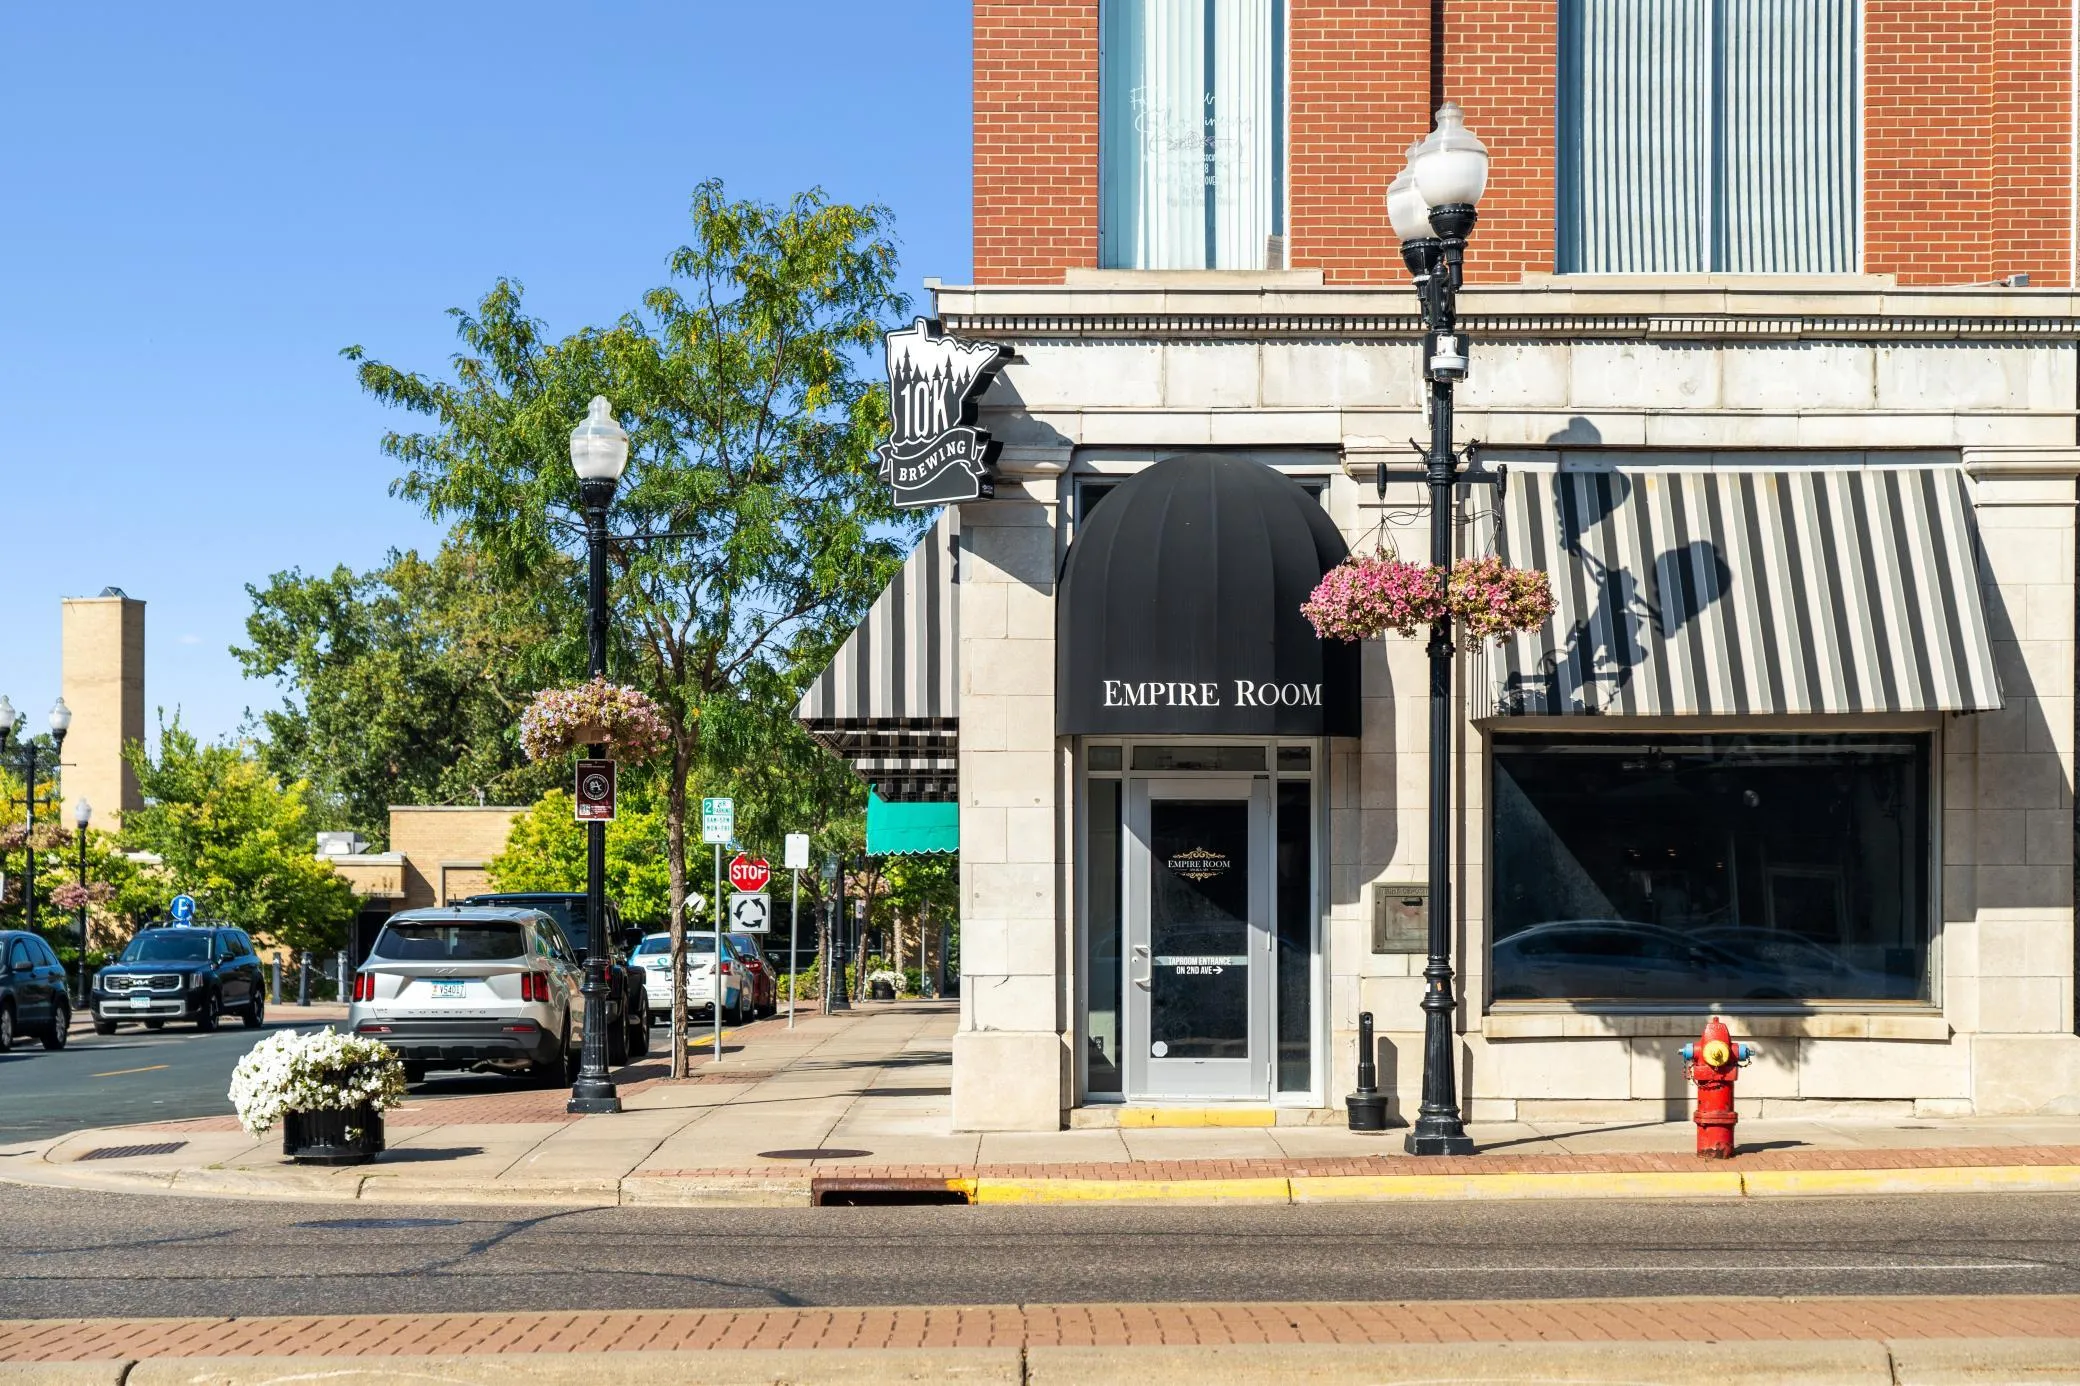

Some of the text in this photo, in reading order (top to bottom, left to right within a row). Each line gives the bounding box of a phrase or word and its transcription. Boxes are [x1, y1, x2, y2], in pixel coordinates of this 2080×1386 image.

[901, 377, 949, 439] 10K
[898, 440, 967, 483] BREWING
[1103, 679, 1323, 707] EMPIRE ROOM
[705, 802, 712, 813] 2
[732, 864, 767, 880] STOP
[1168, 860, 1231, 868] EMPIRE ROOM
[178, 898, 189, 917] P
[1169, 956, 1232, 965] TAPROOM ENTRANCE
[1176, 966, 1213, 975] ON 2ND AVE
